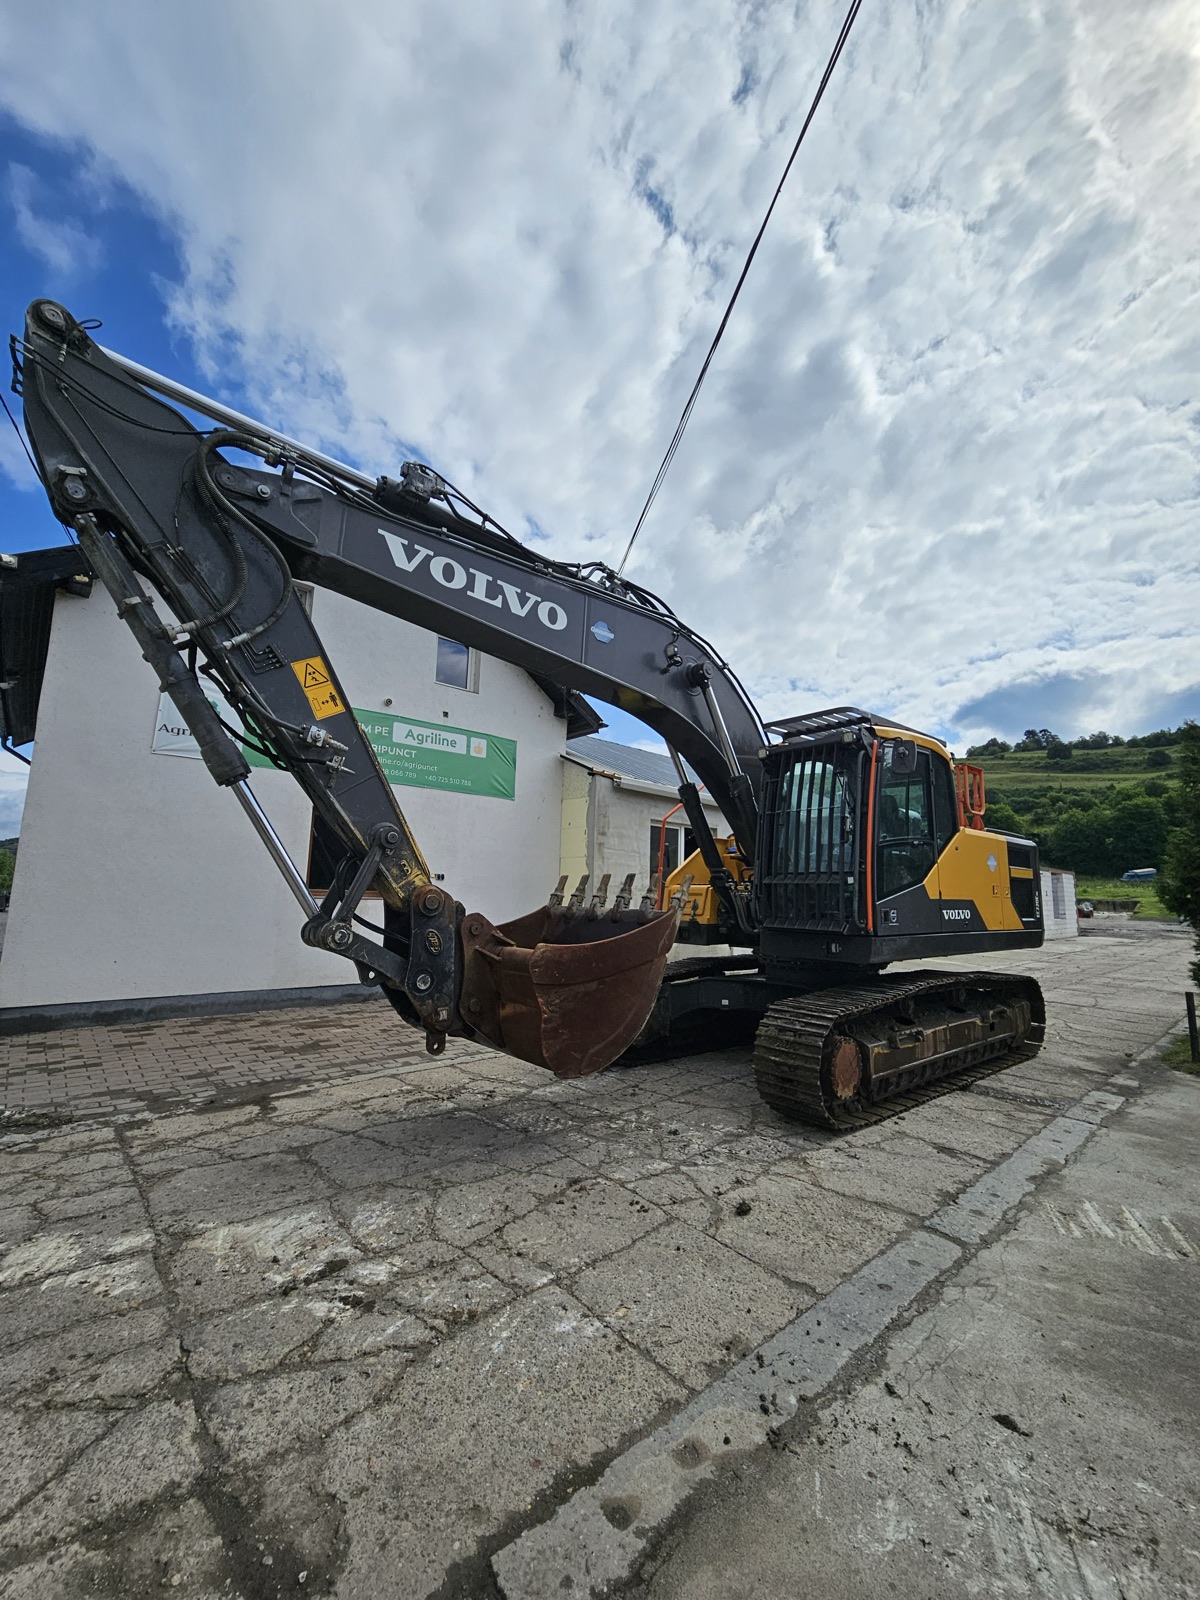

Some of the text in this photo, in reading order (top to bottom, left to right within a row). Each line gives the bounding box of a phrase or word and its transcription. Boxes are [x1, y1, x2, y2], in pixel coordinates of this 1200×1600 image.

[378, 528, 568, 631] VOLVO
[375, 725, 389, 736] PE
[404, 728, 457, 748] Agriline
[371, 744, 417, 758] RIPUNCT
[378, 757, 438, 771] line.ro/agripunct
[405, 771, 417, 779] 789
[942, 909, 971, 920] VOLVO
